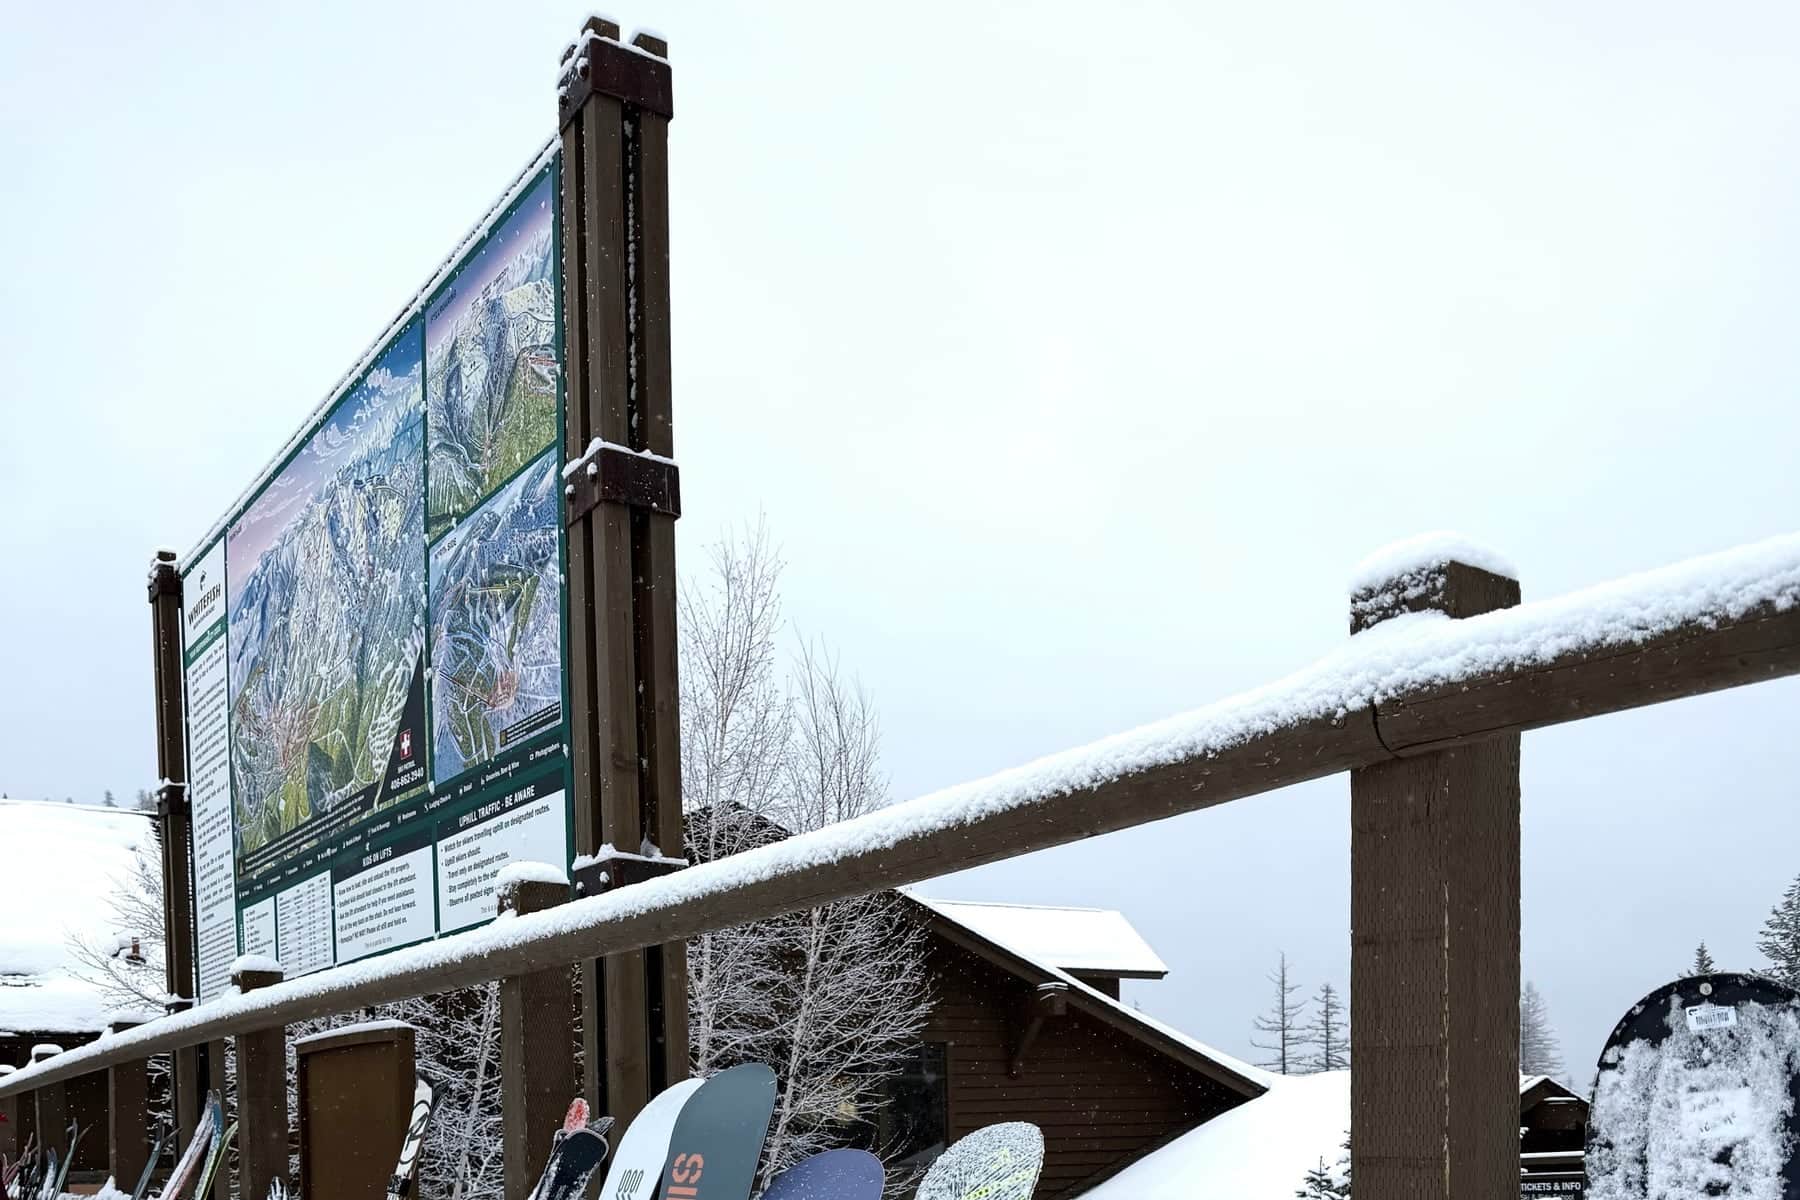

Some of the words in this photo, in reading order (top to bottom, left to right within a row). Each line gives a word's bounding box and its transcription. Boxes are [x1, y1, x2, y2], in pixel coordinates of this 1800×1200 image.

[188, 583, 221, 625] WHITEFISH
[459, 810, 477, 827] UPHILL
[478, 800, 500, 820] TRAFFIC
[504, 796, 513, 808] BE
[513, 785, 535, 803] AWARE
[362, 855, 372, 867] KIDS
[372, 852, 379, 862] ON
[380, 846, 392, 860] LIFTS
[1520, 1182, 1552, 1191] TICKETS
[1553, 1182, 1560, 1190] &
[1561, 1182, 1581, 1191] INFO
